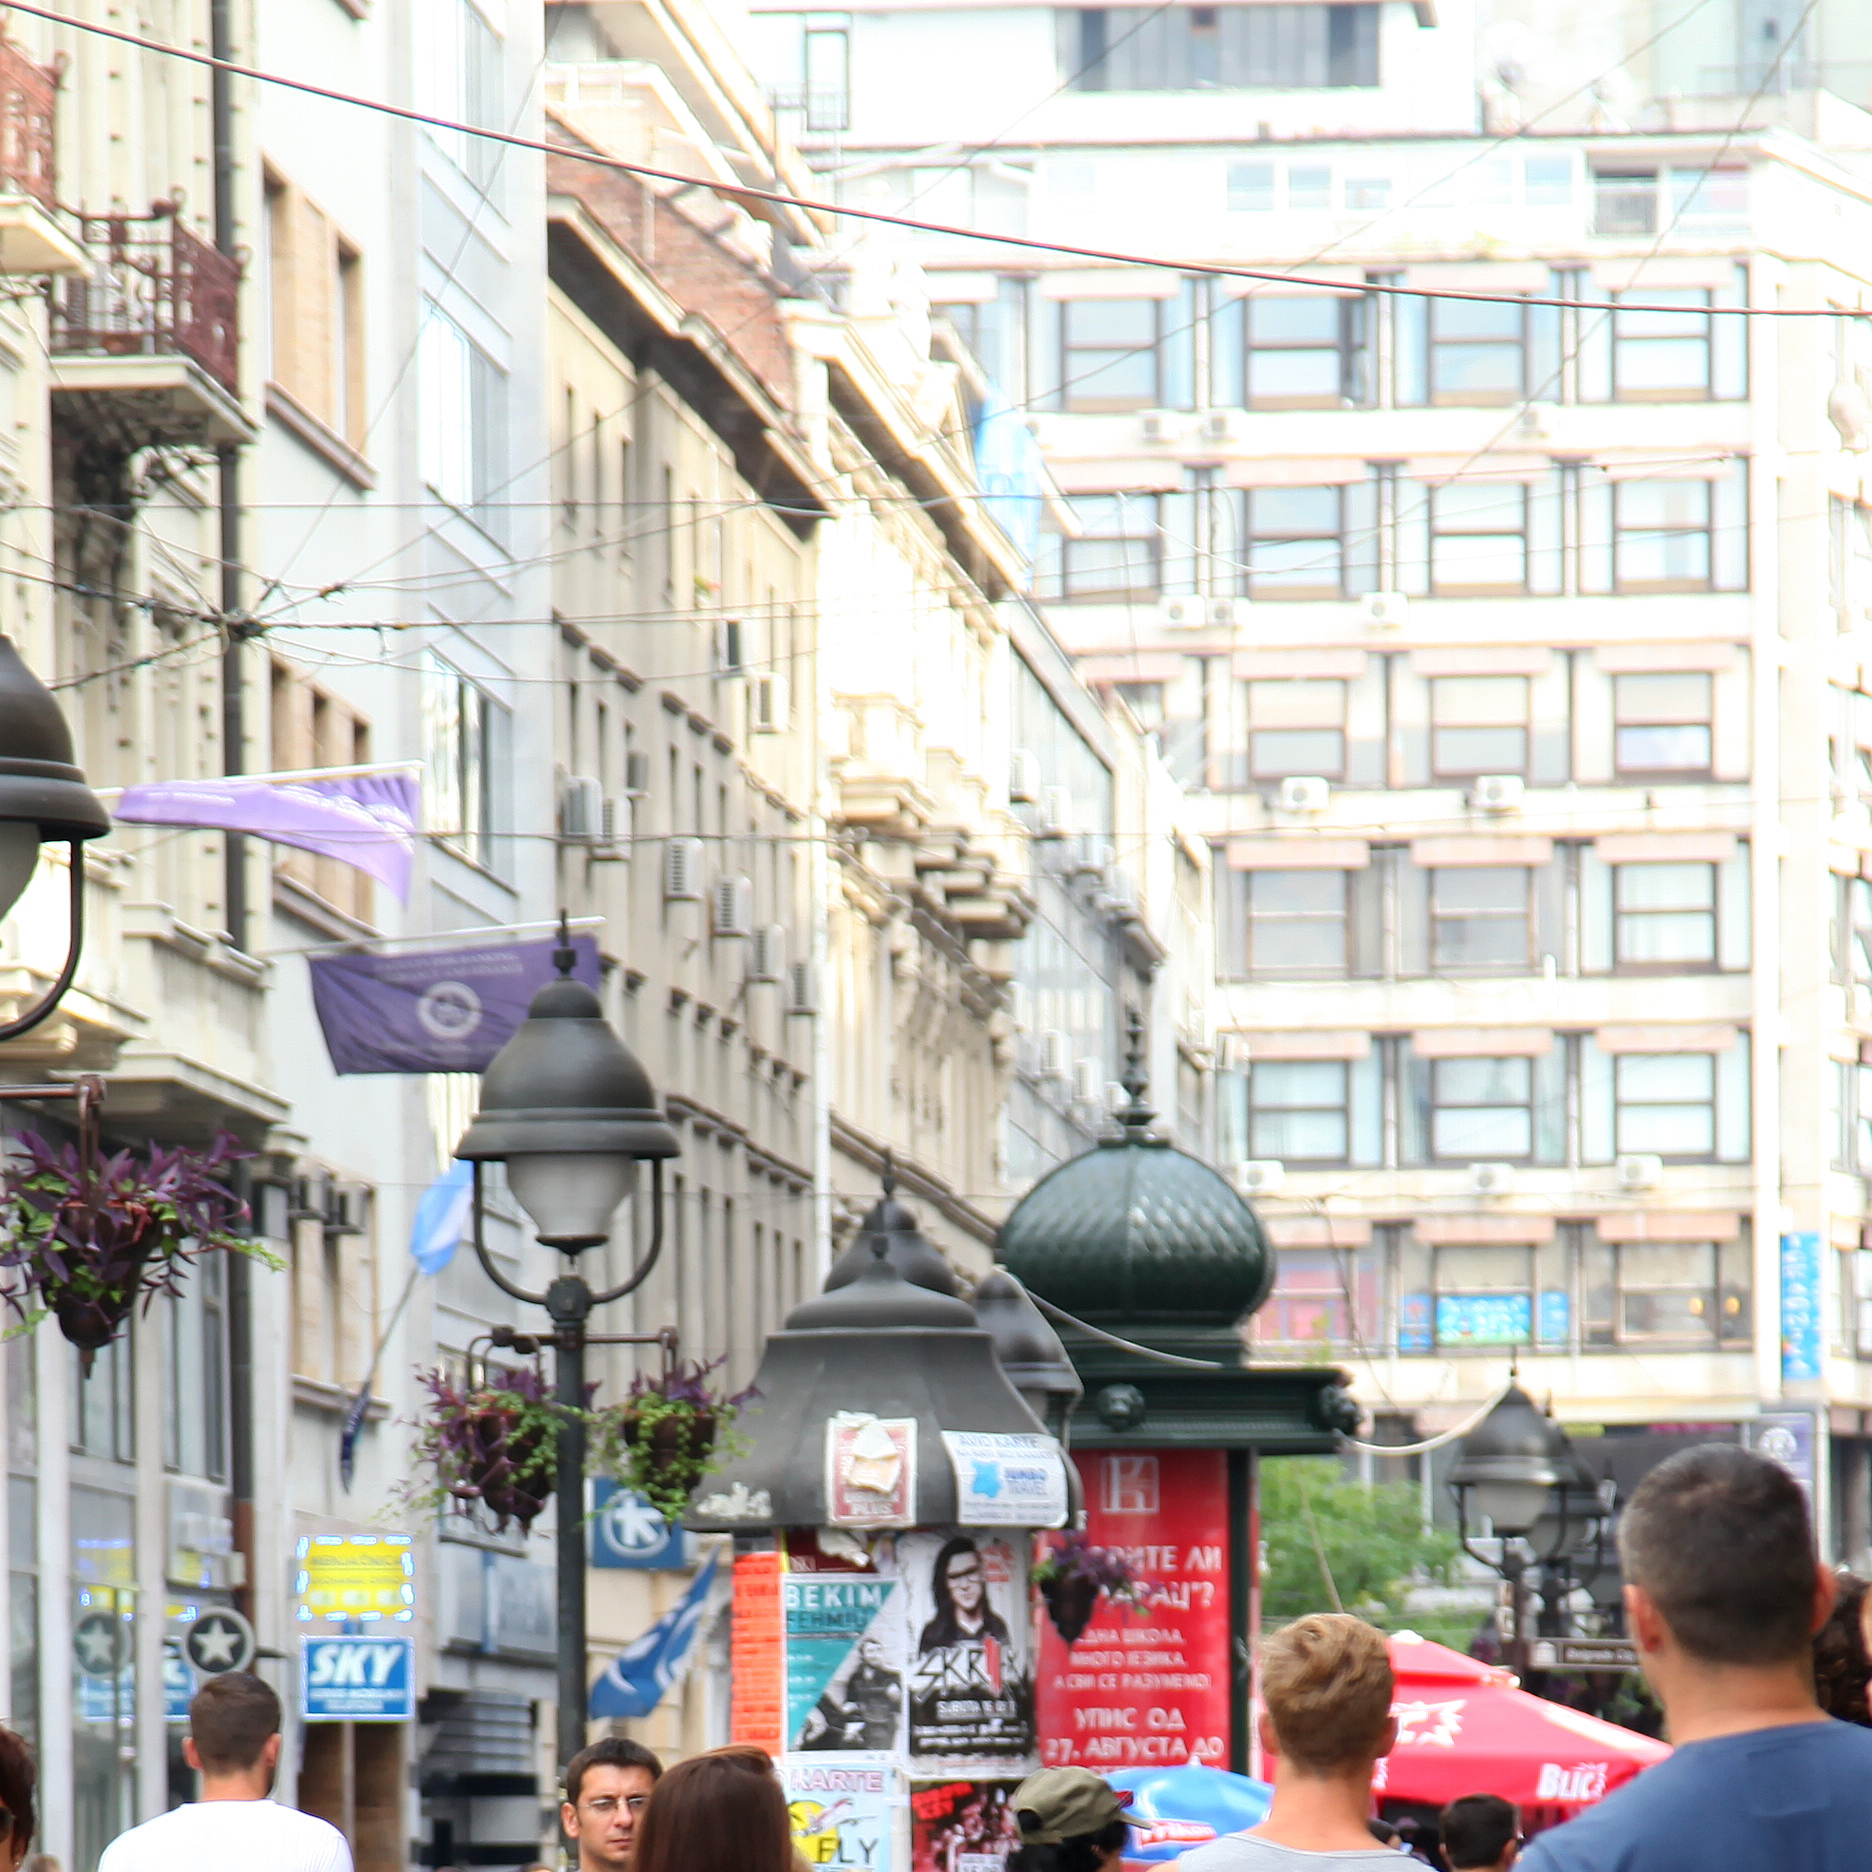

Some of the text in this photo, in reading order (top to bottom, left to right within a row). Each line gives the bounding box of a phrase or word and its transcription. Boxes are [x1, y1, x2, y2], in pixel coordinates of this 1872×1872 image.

[787, 1584, 883, 1609] BEKIM
[309, 1643, 404, 1687] SKY
[1074, 1707, 1187, 1731] УПИС ОД
[1084, 1737, 1189, 1760] АВГУСТА
[790, 1769, 884, 1793] KARTE
[814, 1836, 880, 1864] FLY
